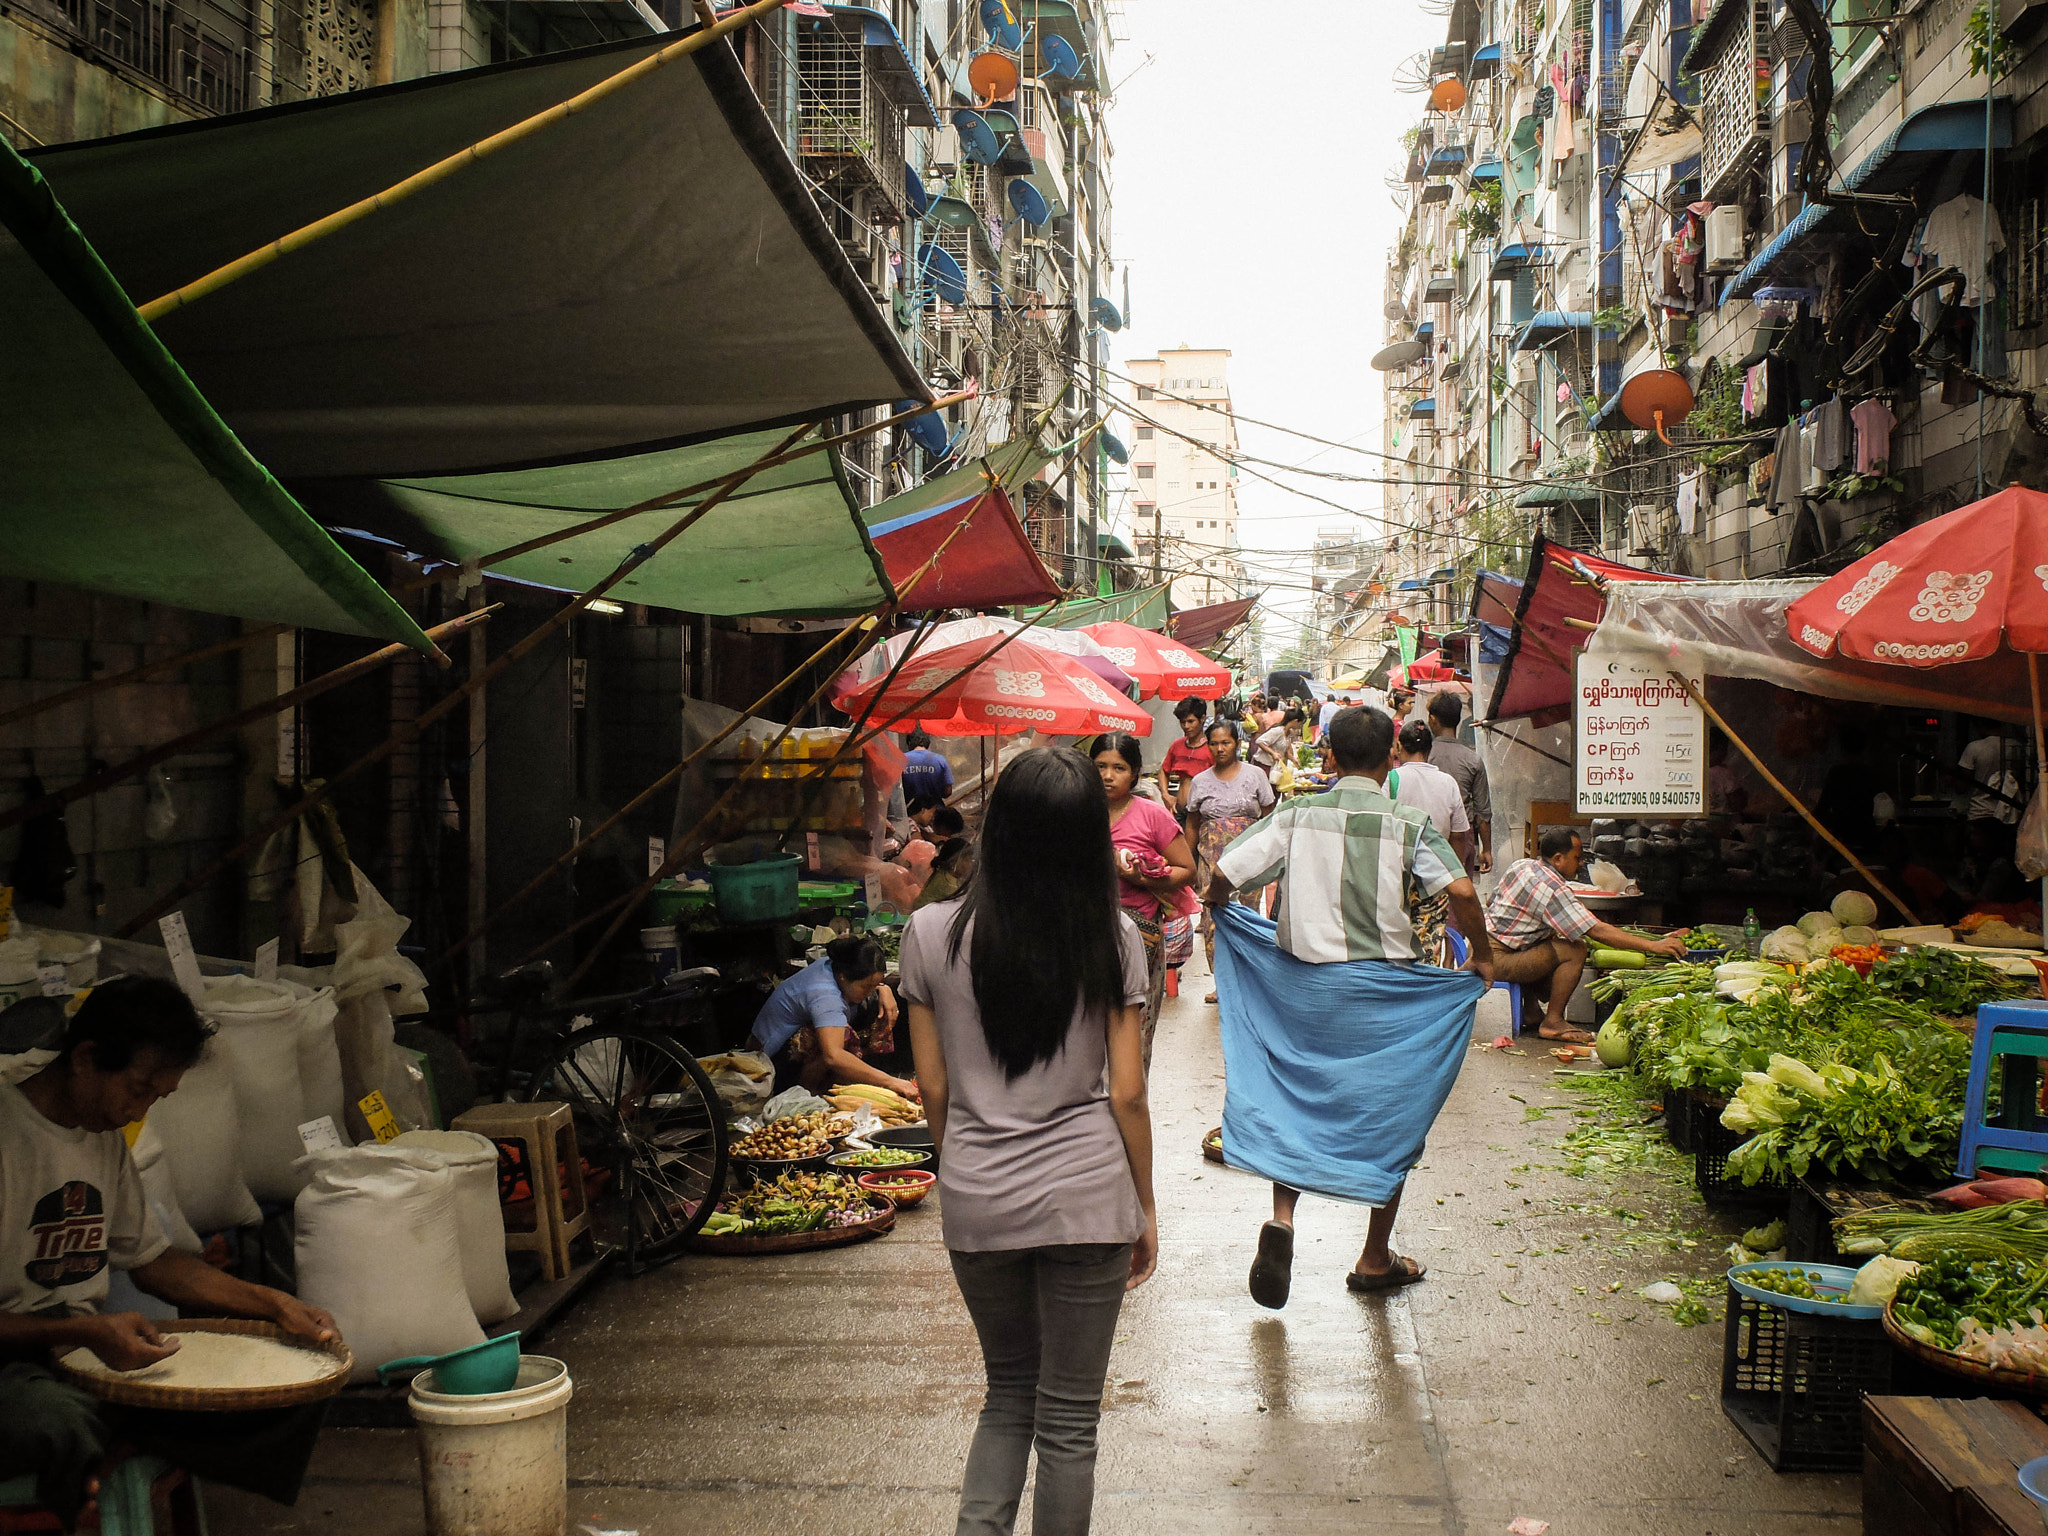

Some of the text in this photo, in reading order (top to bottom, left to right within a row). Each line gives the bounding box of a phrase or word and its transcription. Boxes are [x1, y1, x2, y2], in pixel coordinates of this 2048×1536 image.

[1874, 641, 1969, 660] ooredoo
[984, 703, 1057, 722] ooredoo
[903, 765, 935, 775] KENBO
[1667, 771, 1692, 783] 5000
[1579, 792, 1700, 808] Ph 09 421127905, 09 5400579
